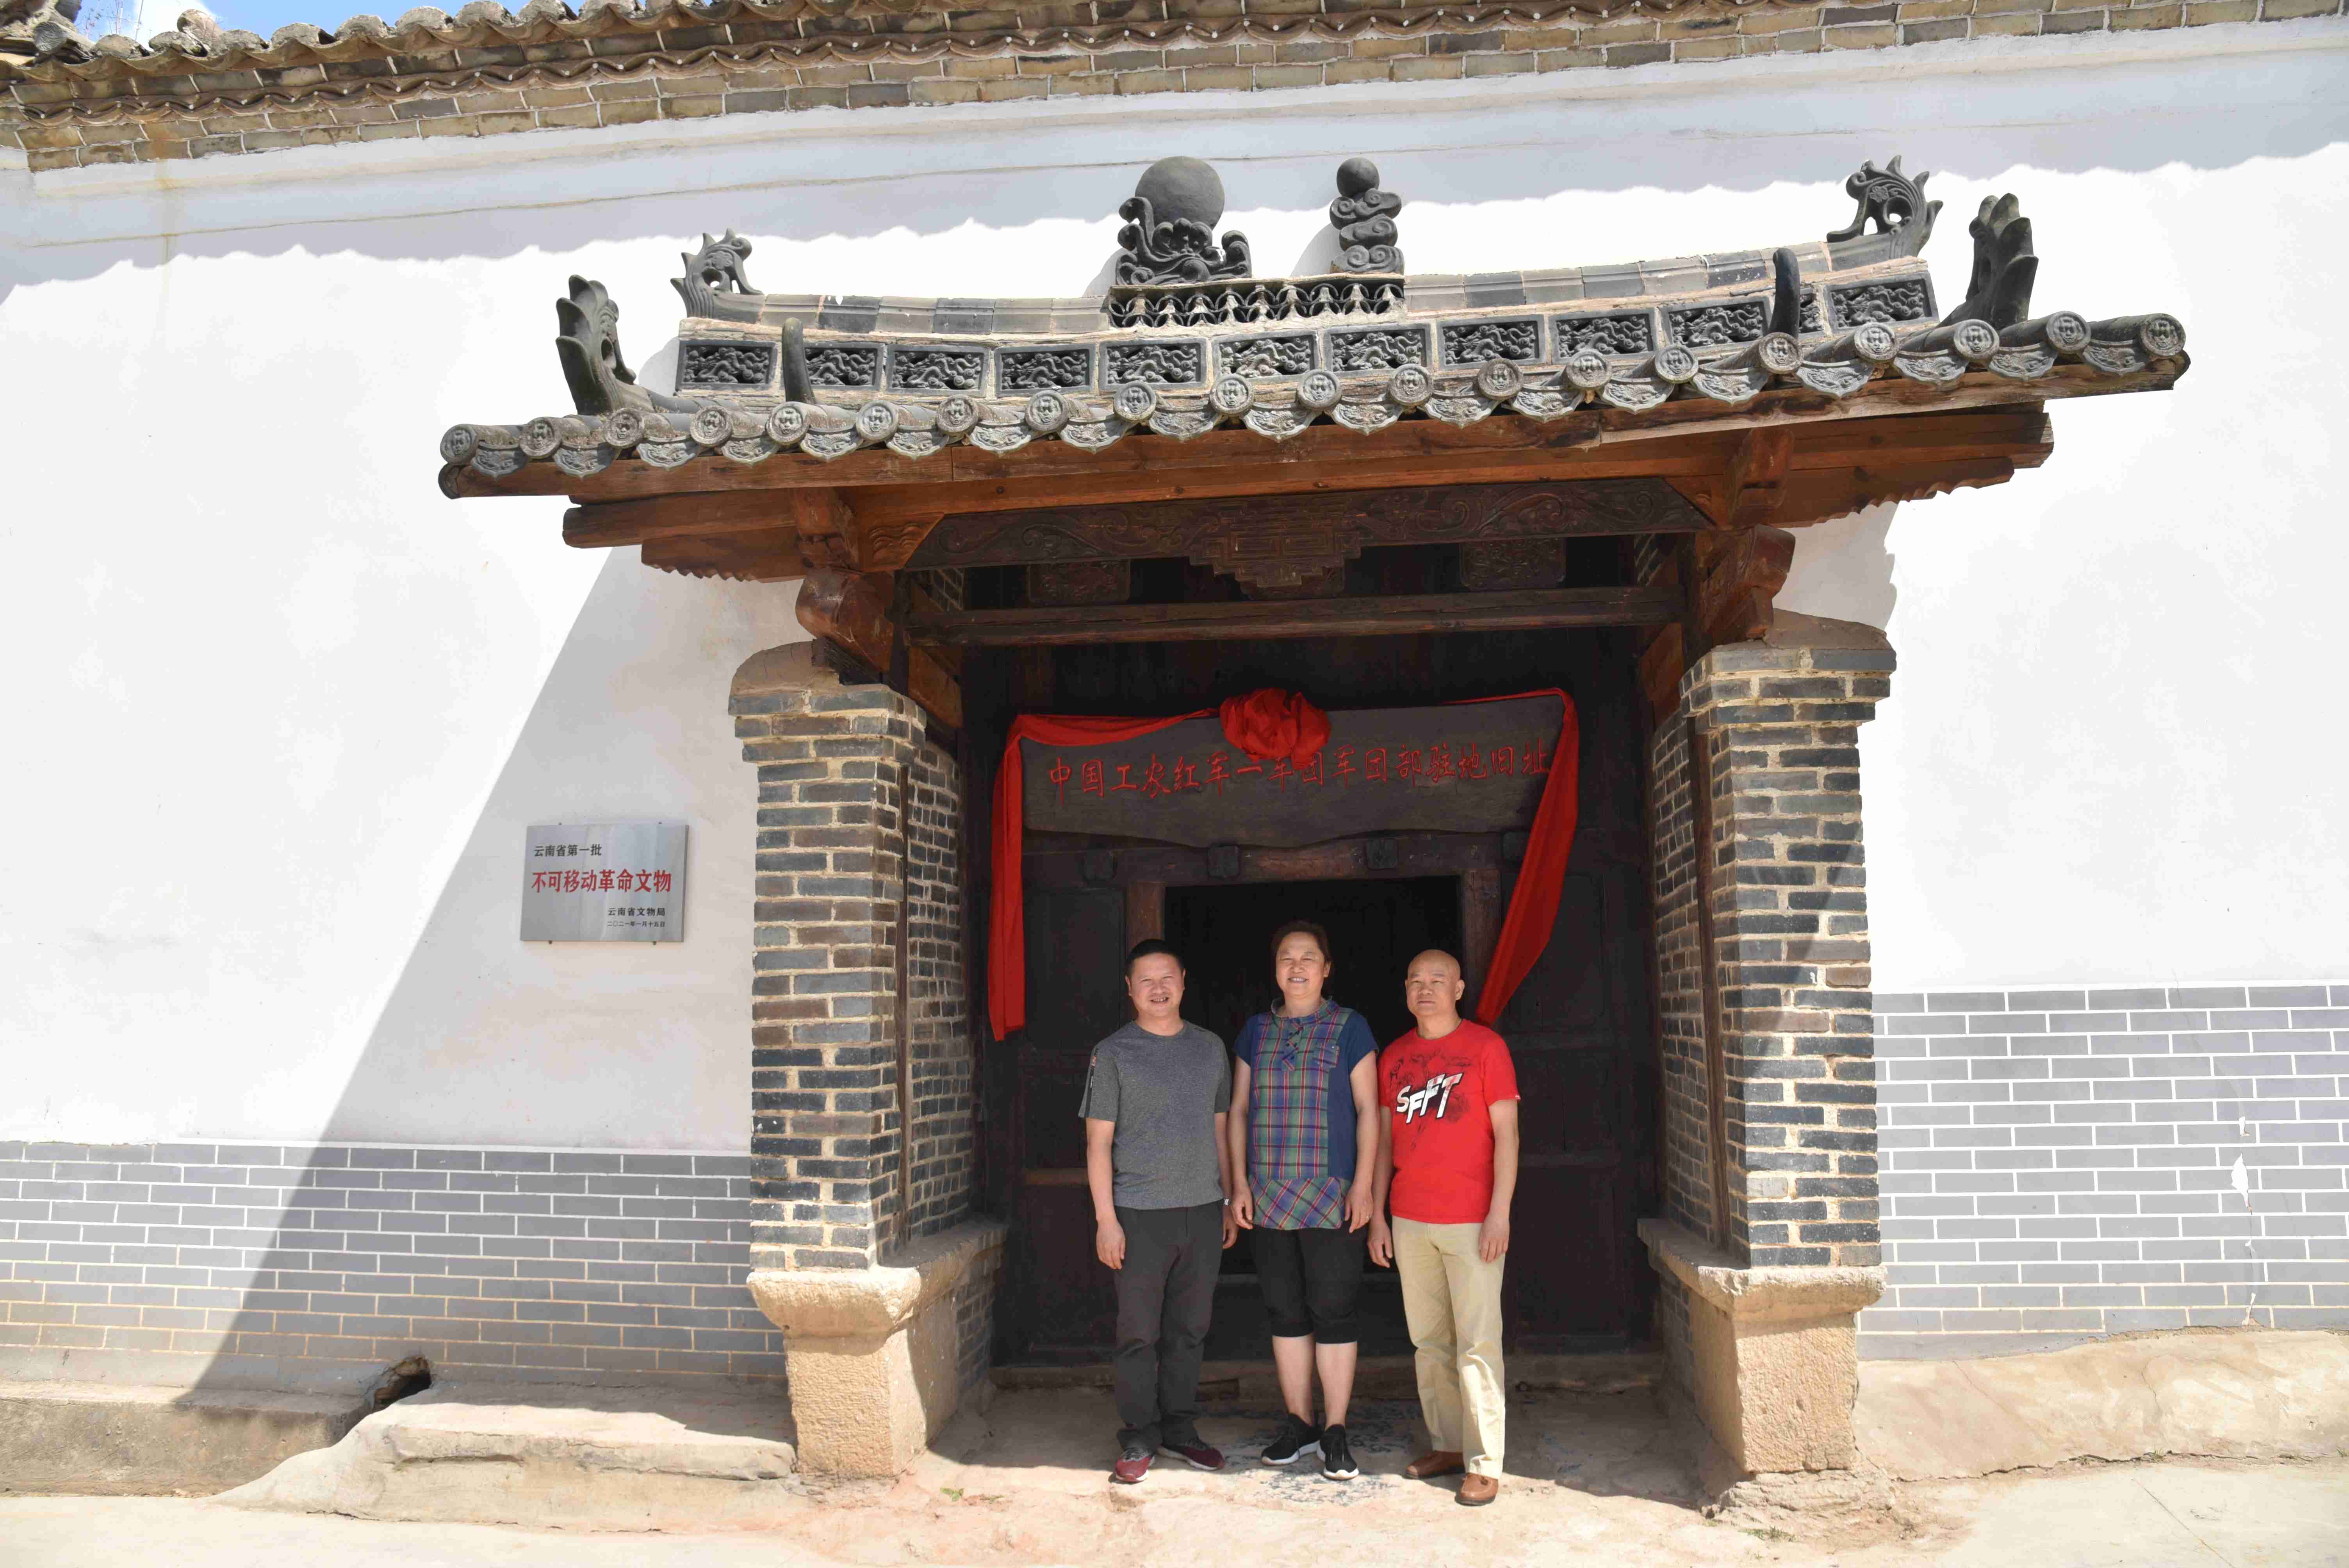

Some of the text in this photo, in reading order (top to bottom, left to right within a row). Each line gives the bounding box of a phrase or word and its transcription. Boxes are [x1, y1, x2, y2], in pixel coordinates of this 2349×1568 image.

[534, 844, 602, 857] 云南省第一批
[531, 868, 672, 893] 不可移动革命文物
[608, 907, 665, 916] 云南省文物局
